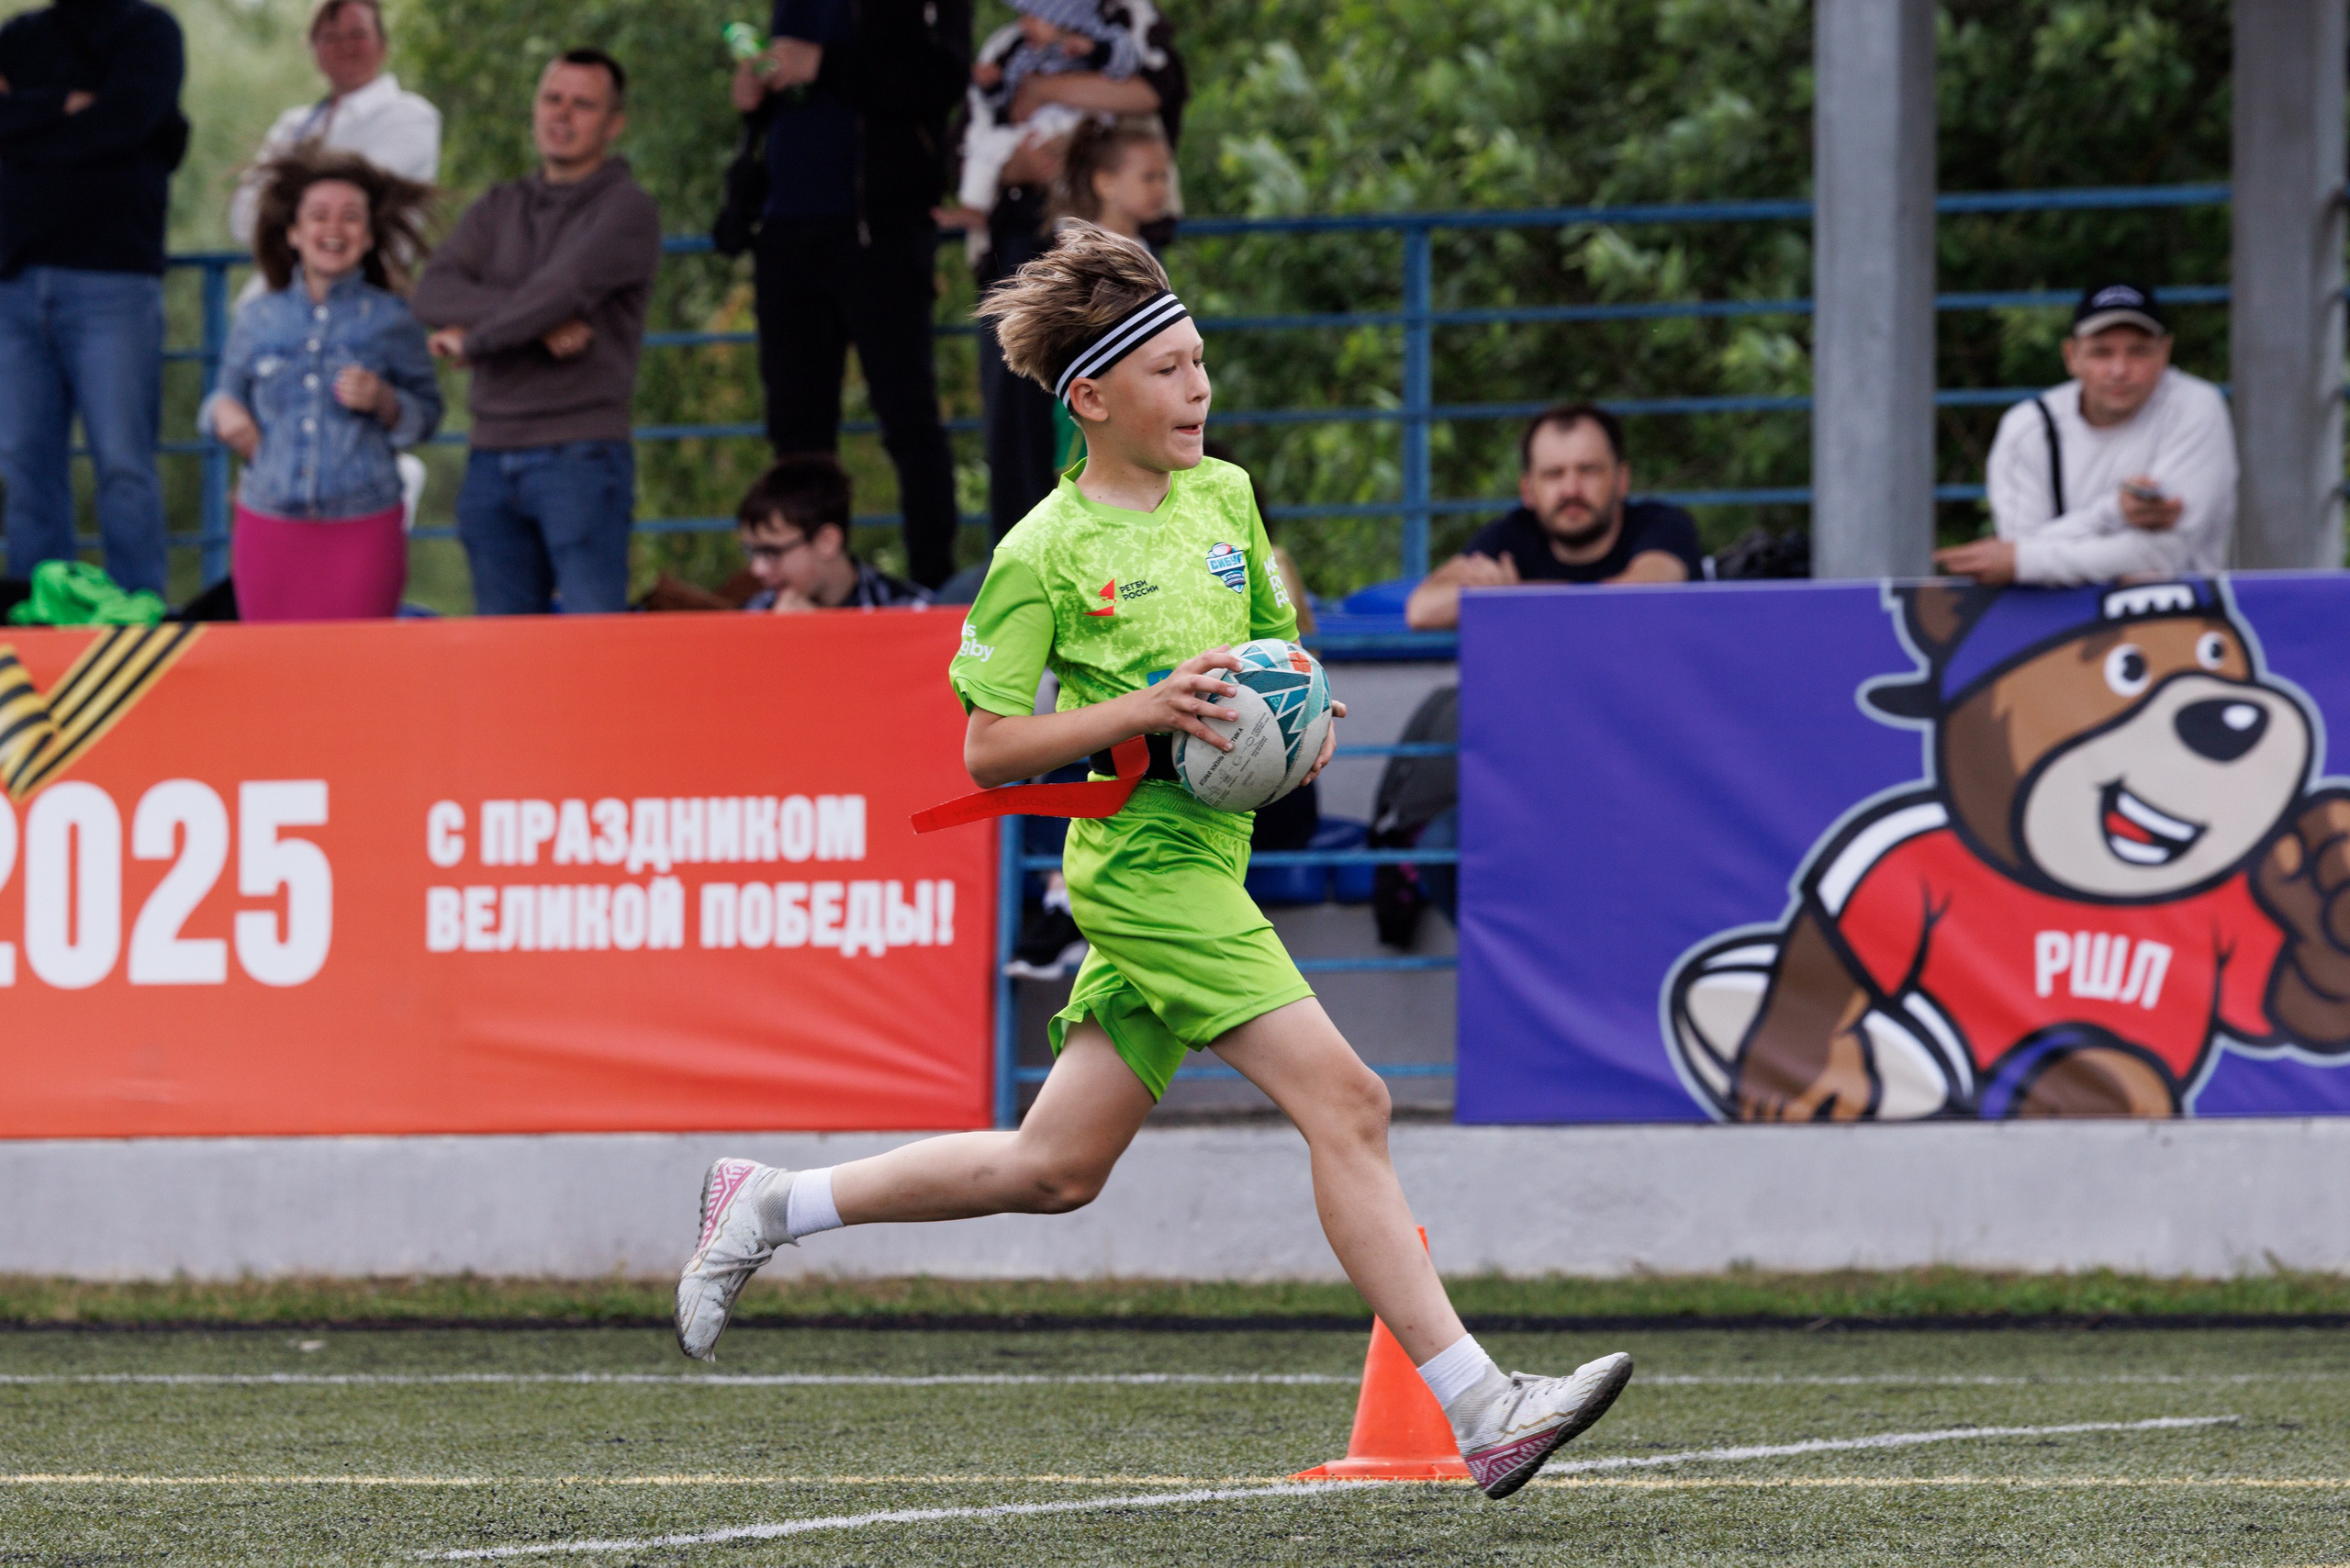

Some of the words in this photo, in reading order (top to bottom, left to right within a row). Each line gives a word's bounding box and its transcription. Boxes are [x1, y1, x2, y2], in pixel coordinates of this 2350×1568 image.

[1119, 580, 1147, 593] РЕГБИ
[1122, 585, 1159, 601] РОССИИ
[958, 638, 995, 662] gby
[1221, 727, 1244, 756] ПТИКА
[427, 800, 465, 868] С
[479, 794, 867, 875] ПРАЗДНИКОМ
[0, 778, 333, 990] 025
[425, 874, 685, 953] ВЕЛИКОЙ
[699, 879, 956, 958] ПОБЕДЫ!
[2034, 929, 2174, 1011] РШЛ
